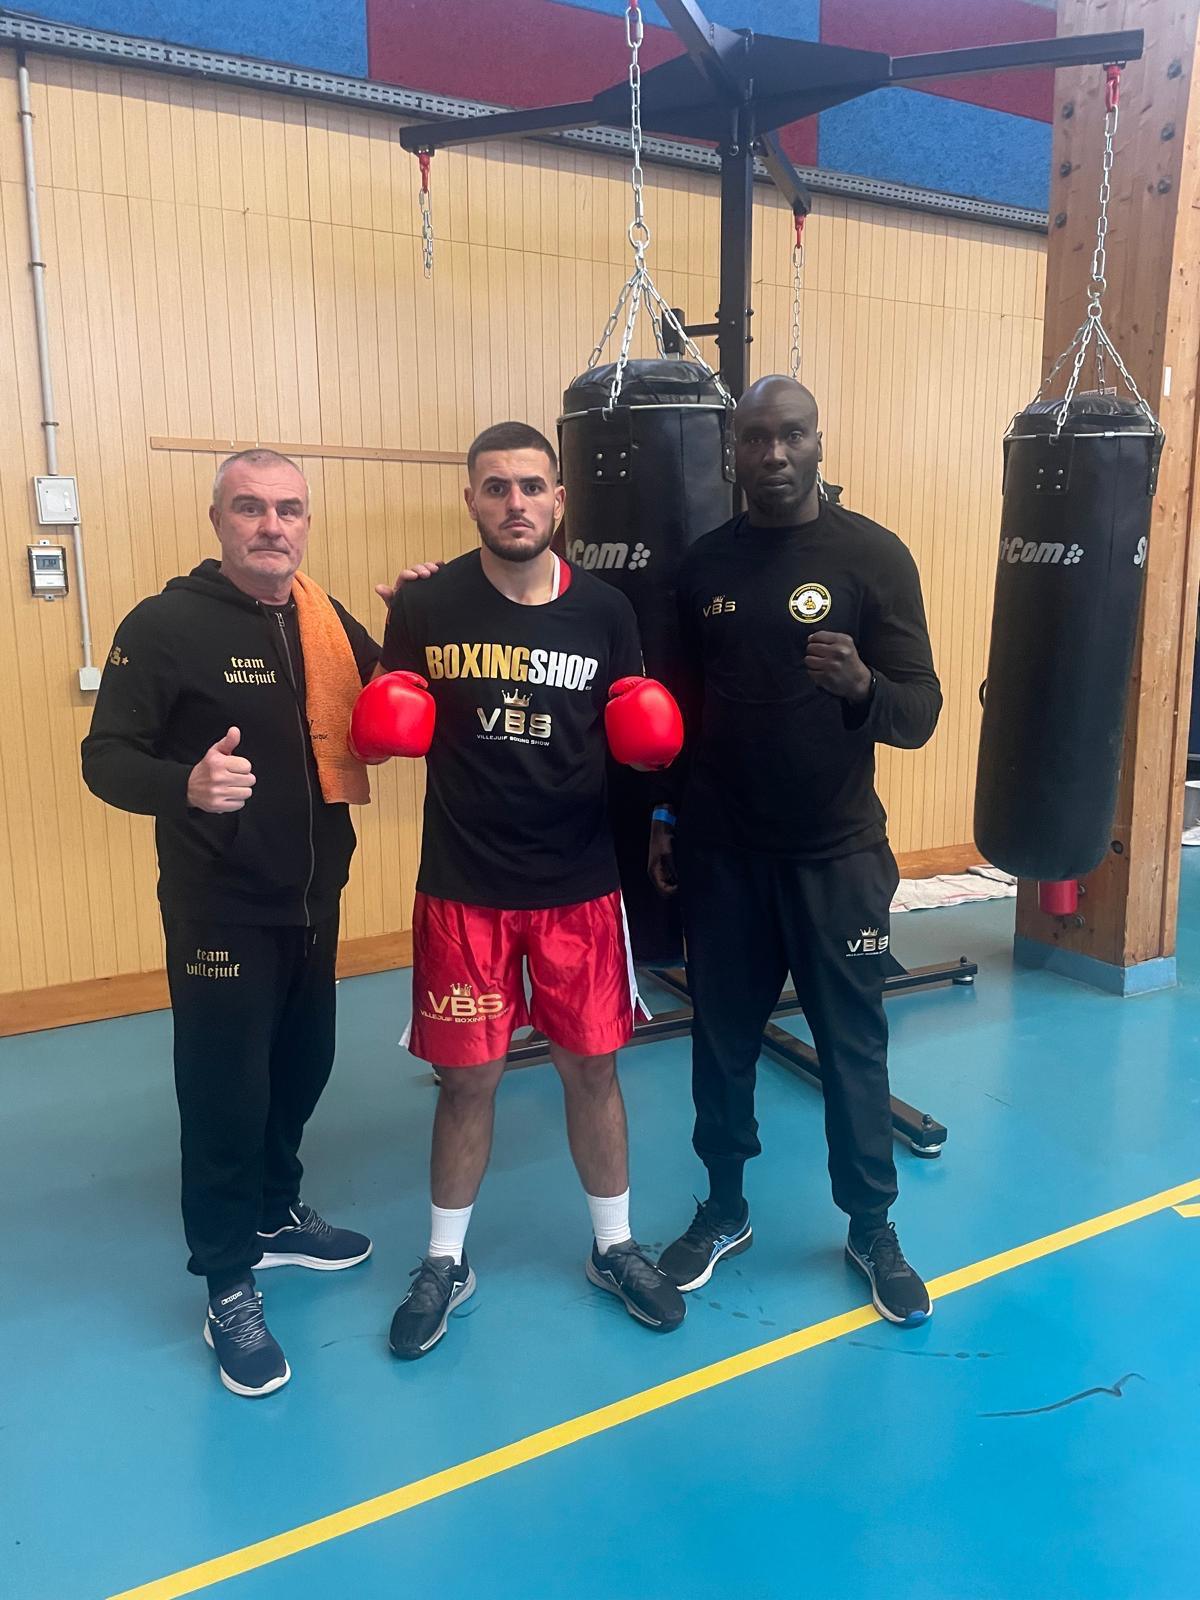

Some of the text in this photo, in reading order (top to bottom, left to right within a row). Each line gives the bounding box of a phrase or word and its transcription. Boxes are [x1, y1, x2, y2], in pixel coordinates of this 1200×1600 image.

[703, 600, 736, 617] VBS
[230, 656, 264, 668] team
[425, 643, 598, 691] BOXINGSHOP
[223, 670, 276, 685] villejuif
[476, 707, 551, 738] VBS
[845, 935, 888, 952] VBS
[196, 948, 229, 962] team
[186, 962, 240, 979] villejuif
[427, 990, 503, 1016] VBS
